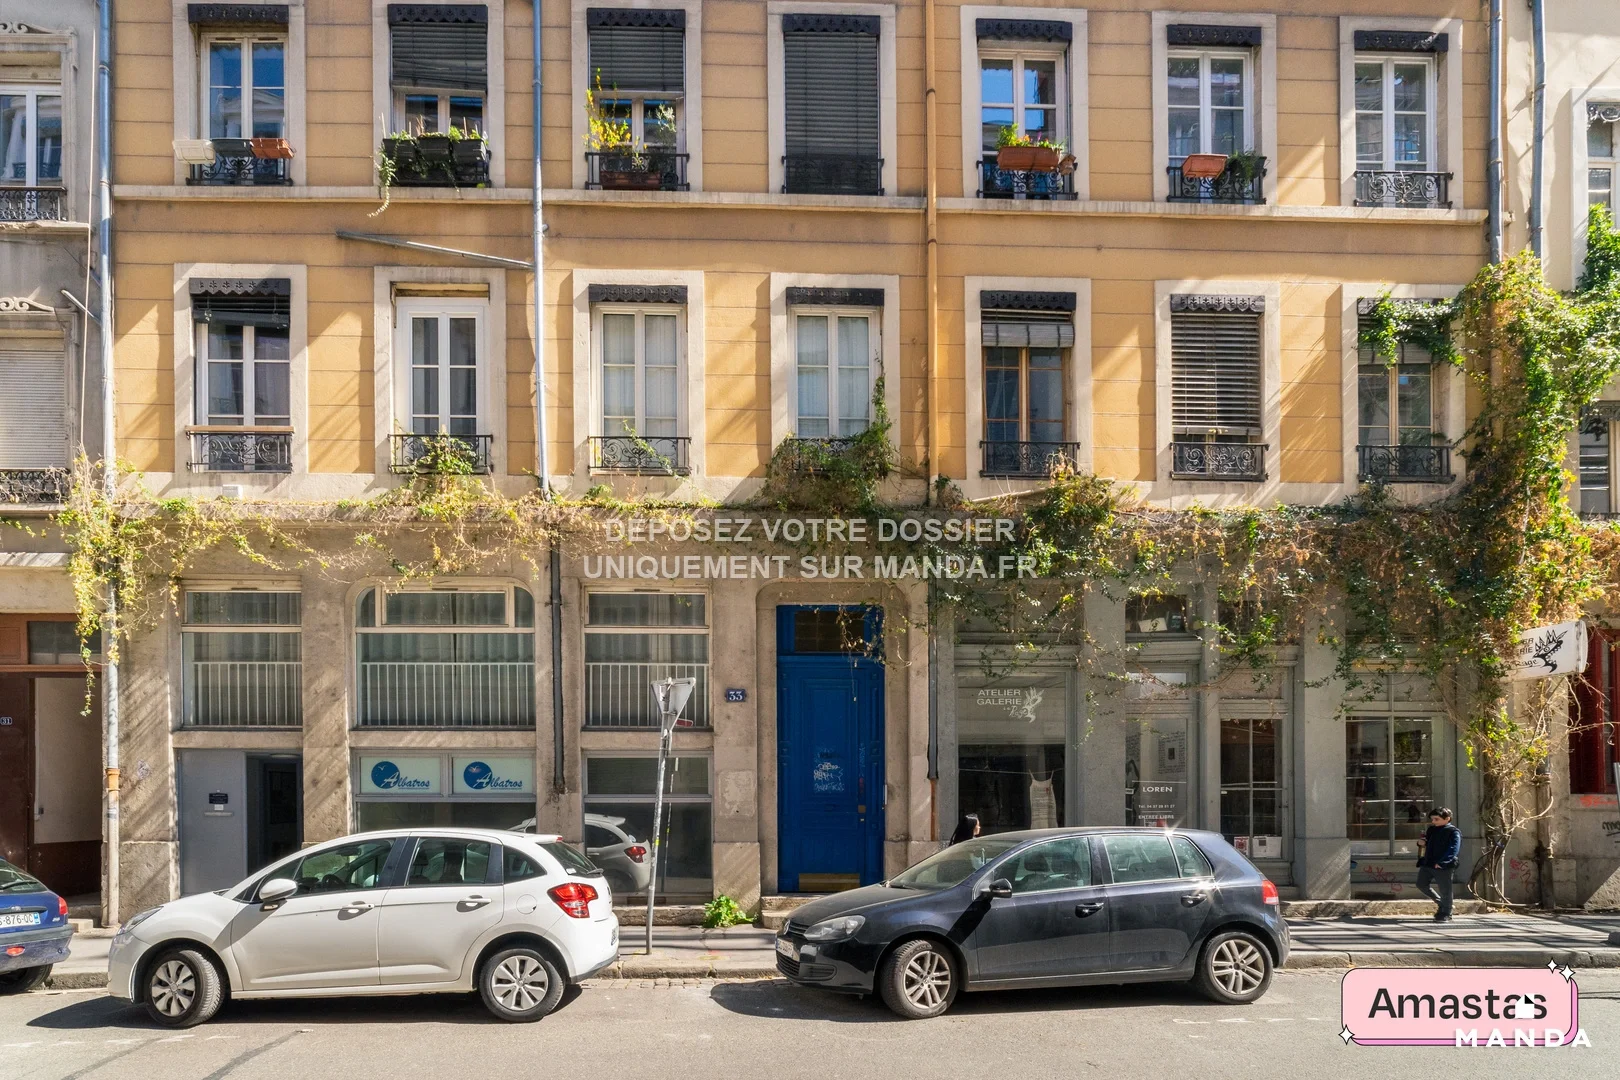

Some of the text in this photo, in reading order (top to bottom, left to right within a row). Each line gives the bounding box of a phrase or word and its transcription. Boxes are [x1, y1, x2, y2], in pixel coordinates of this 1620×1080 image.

[729, 691, 743, 701] 33
[976, 698, 1021, 706] GALERIE
[380, 771, 430, 788] Albatros
[472, 771, 523, 788] Albatros
